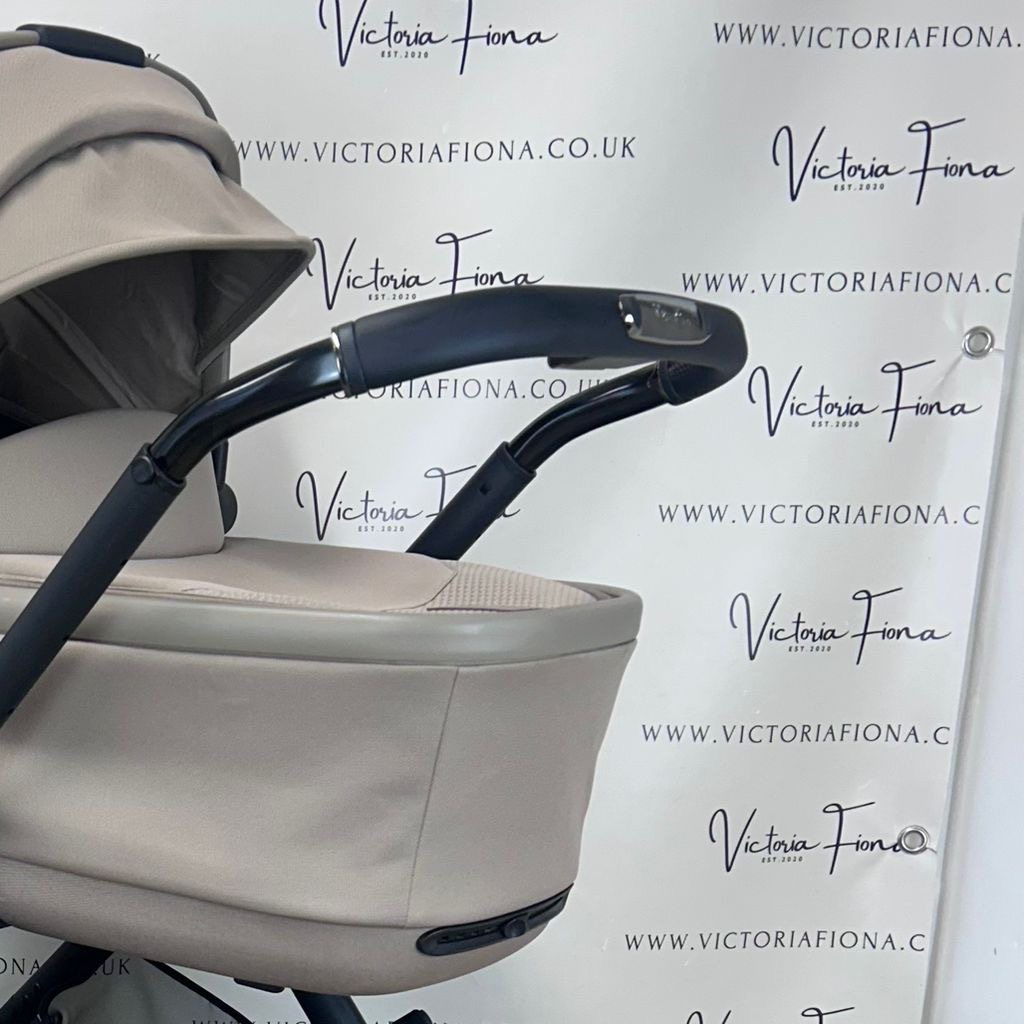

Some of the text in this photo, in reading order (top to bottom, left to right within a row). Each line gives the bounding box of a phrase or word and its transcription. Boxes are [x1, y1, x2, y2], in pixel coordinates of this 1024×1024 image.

[319, 0, 448, 67] Victoria
[772, 118, 1015, 206] Victoria Fiona
[306, 229, 544, 310] Victoria Fiona
[681, 272, 1012, 294] WWW.VICTORIAFIONA.C
[748, 360, 983, 443] Victoria Fiona
[296, 470, 423, 541] Victoria
[659, 504, 981, 525] WWW.VICTORIAFIONA.C
[730, 587, 952, 665] Victoria Fiona
[642, 723, 950, 745] WWW.VICTORIAFIONA.C
[709, 808, 821, 873] Victoria
[625, 930, 925, 951] WWW.VICTORIAFIONA.C
